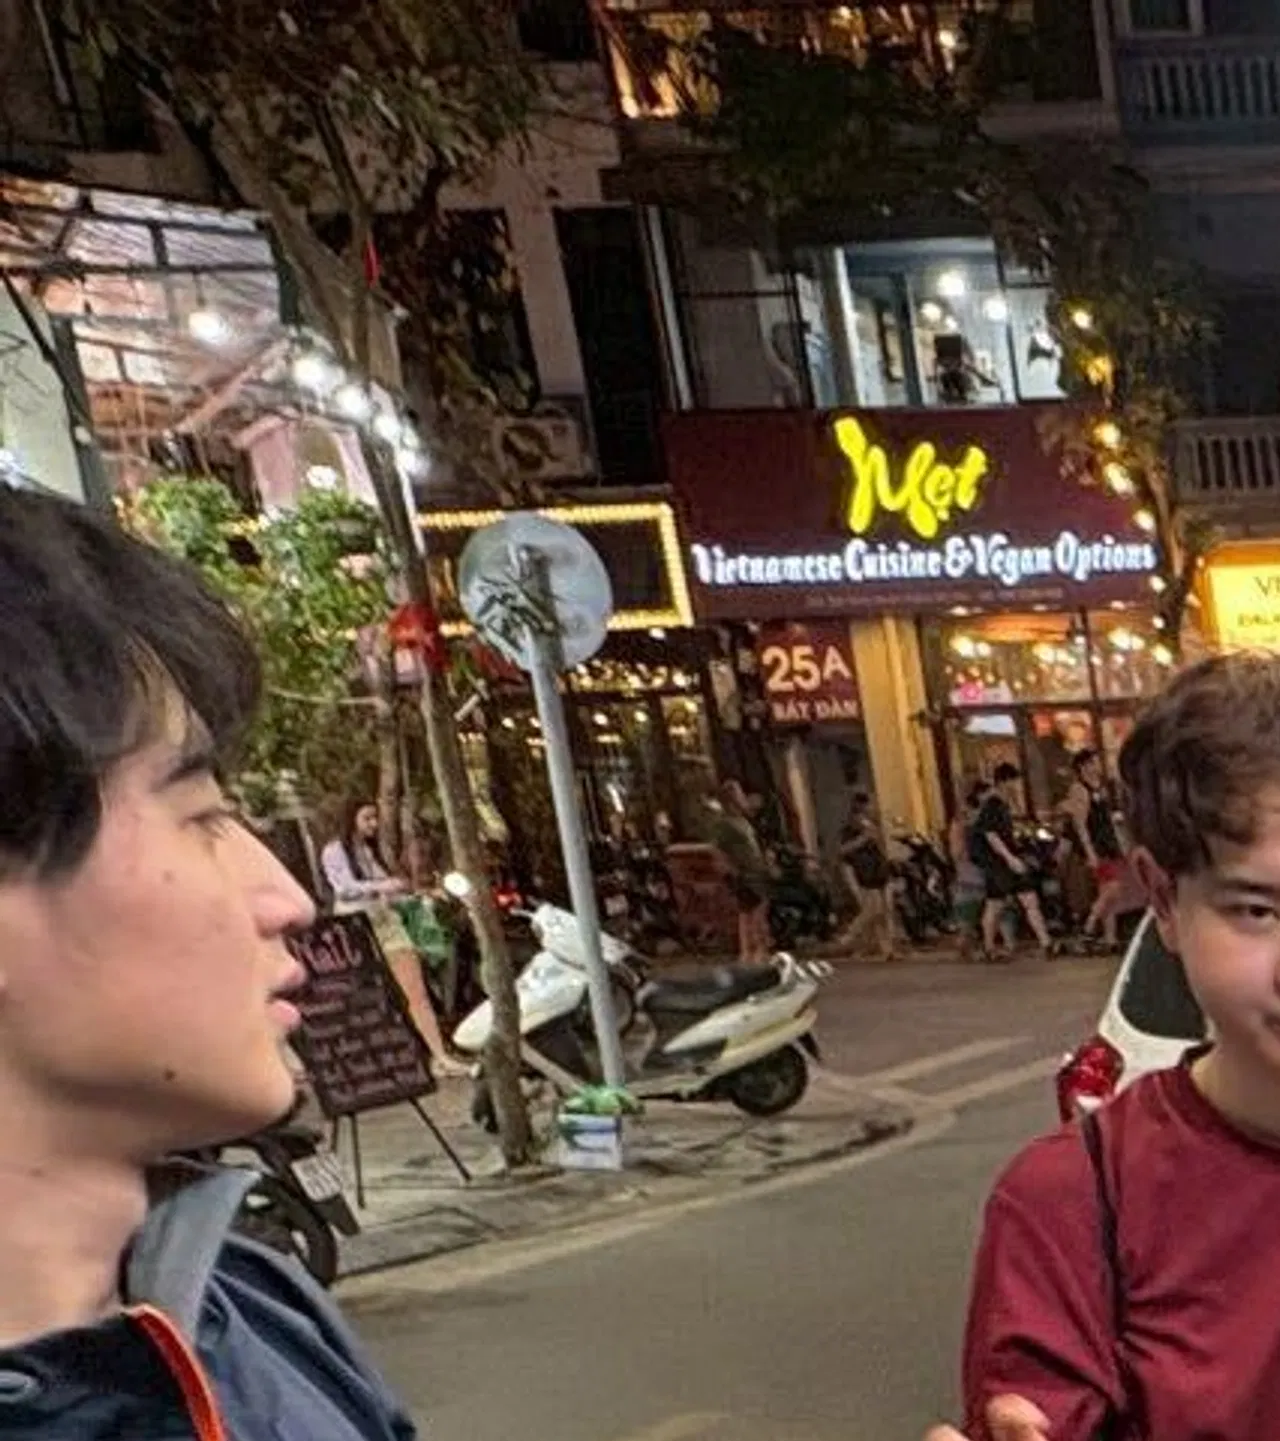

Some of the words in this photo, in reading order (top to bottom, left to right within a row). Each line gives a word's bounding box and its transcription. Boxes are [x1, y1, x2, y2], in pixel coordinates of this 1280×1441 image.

[691, 543, 843, 585] Vietnamese
[844, 538, 942, 582] Cuisine
[944, 535, 974, 578] &
[968, 533, 1052, 586] Vegan
[1054, 531, 1156, 581] Options
[762, 645, 852, 692] 25A
